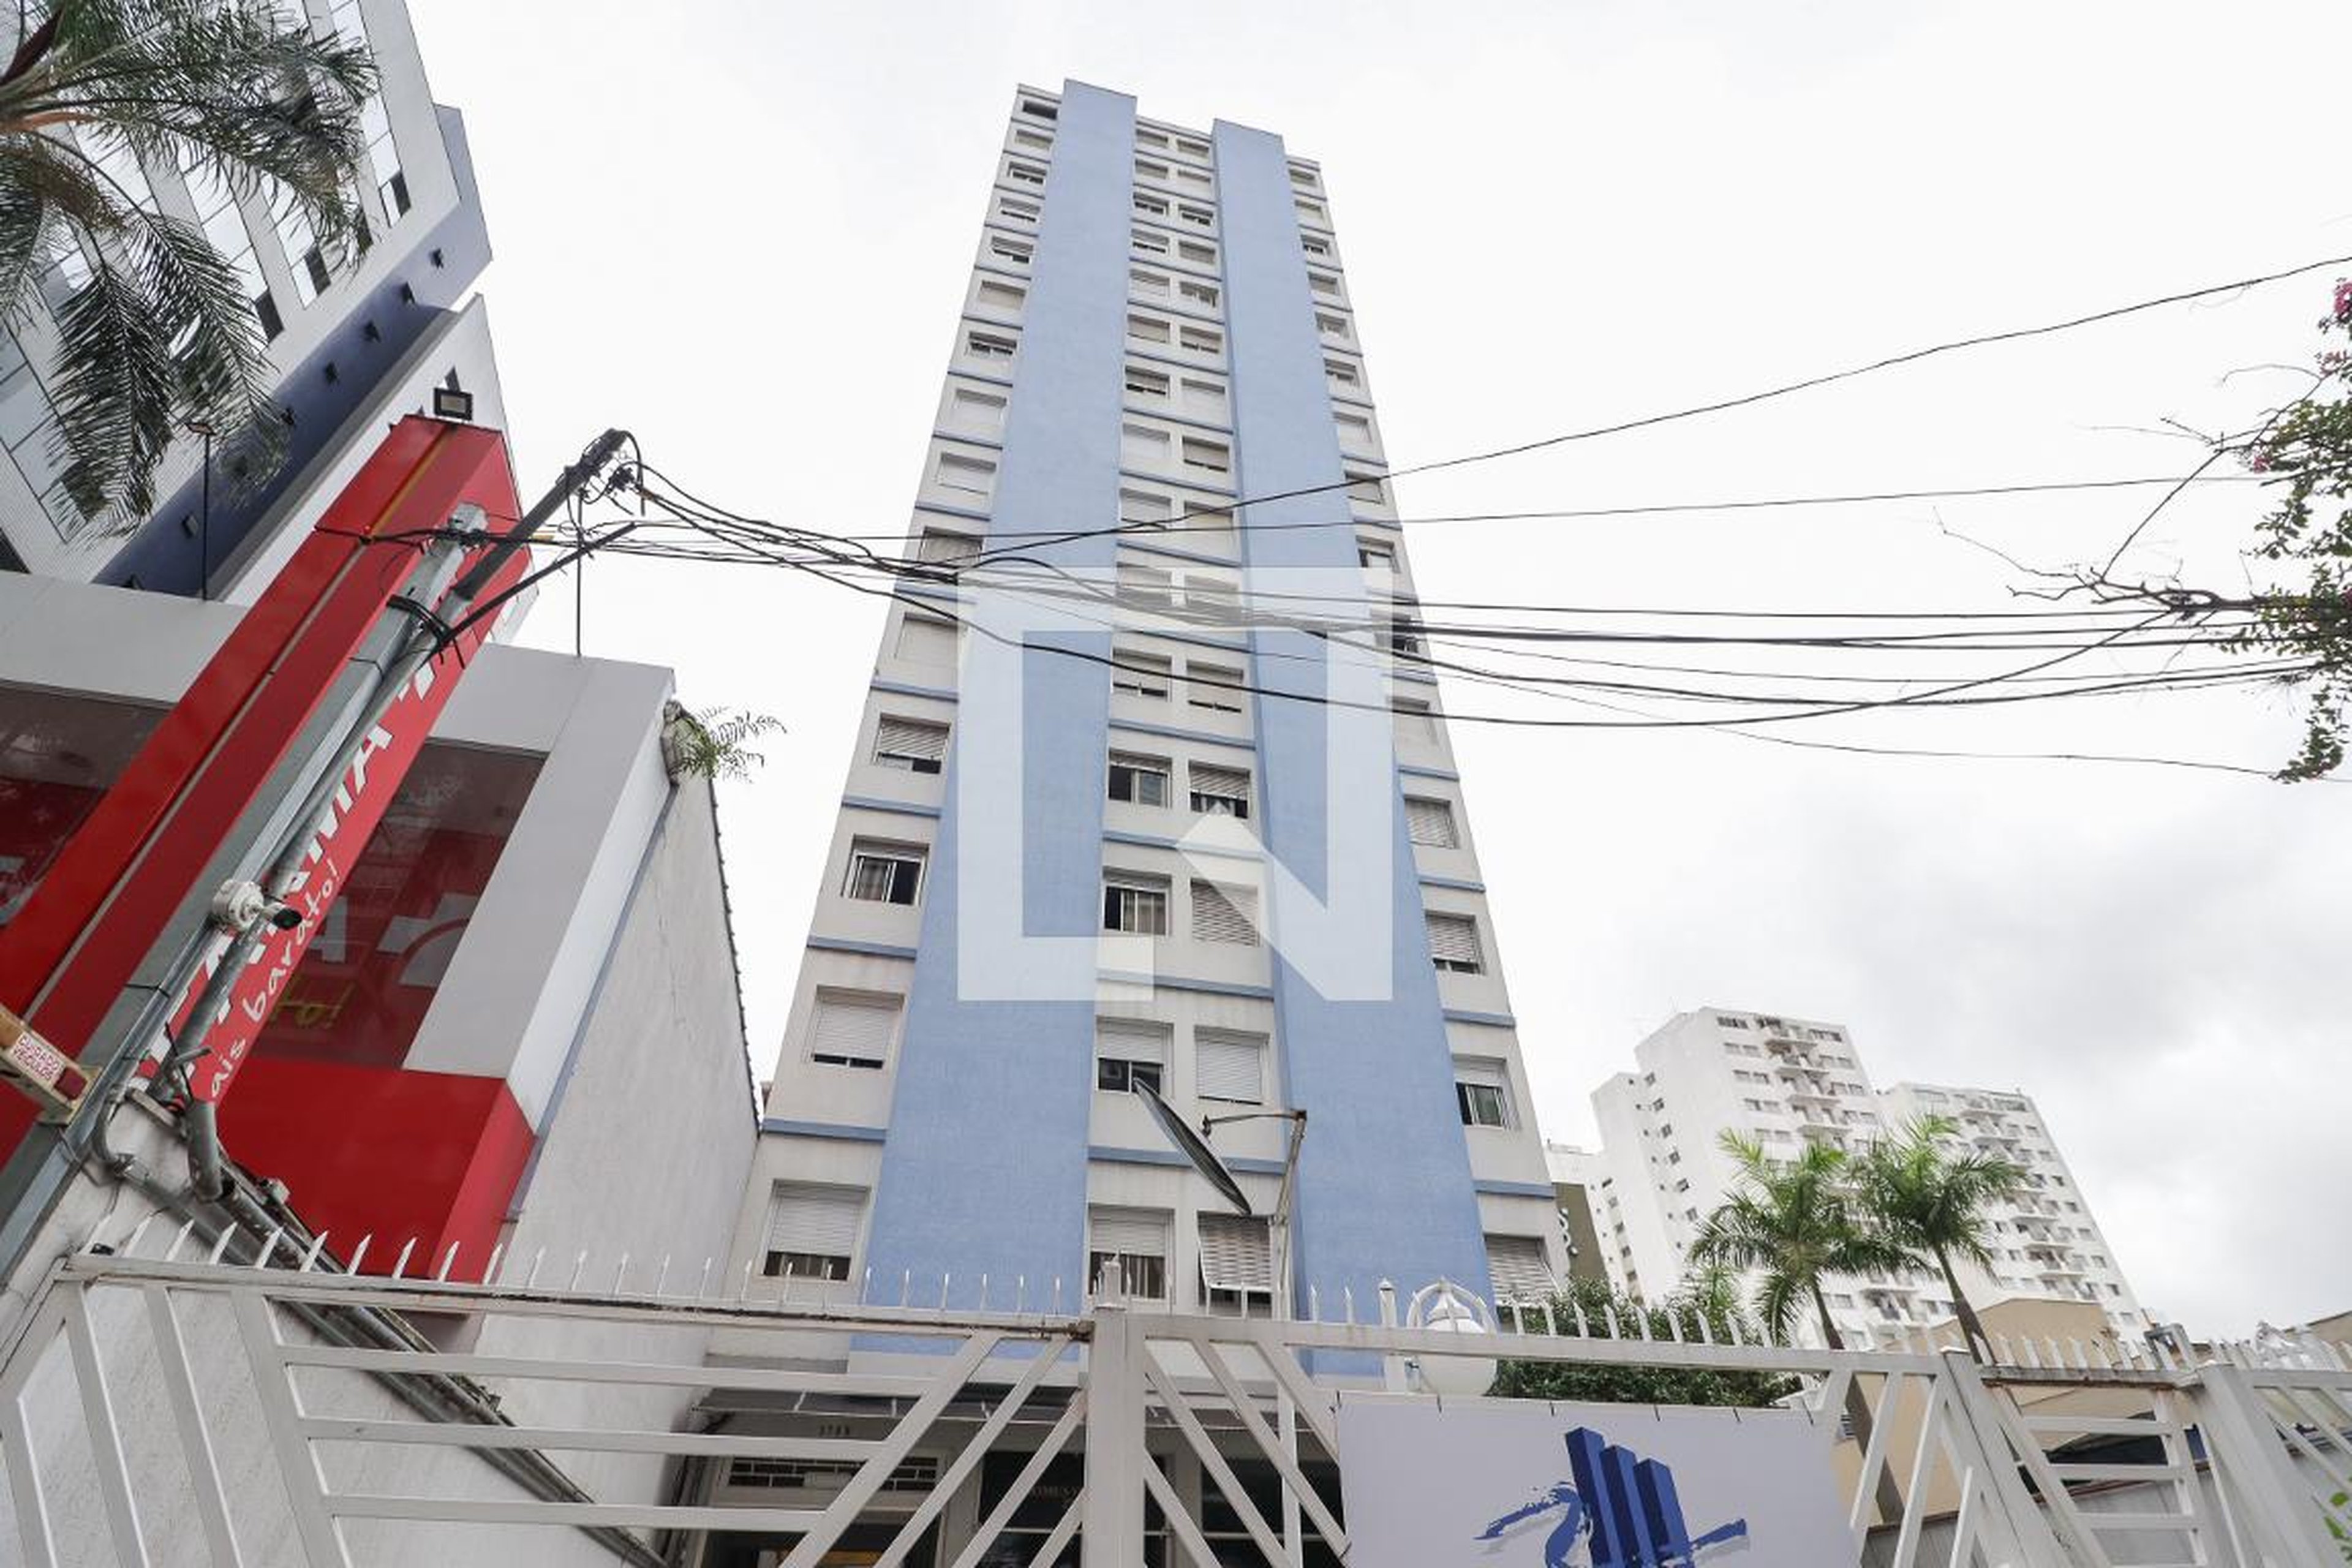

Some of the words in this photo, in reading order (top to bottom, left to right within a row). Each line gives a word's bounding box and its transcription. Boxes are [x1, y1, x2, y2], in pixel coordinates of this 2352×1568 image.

[212, 1039, 246, 1098] ais
[243, 858, 340, 1022] barato!
[19, 1035, 59, 1071] CUIDADO
